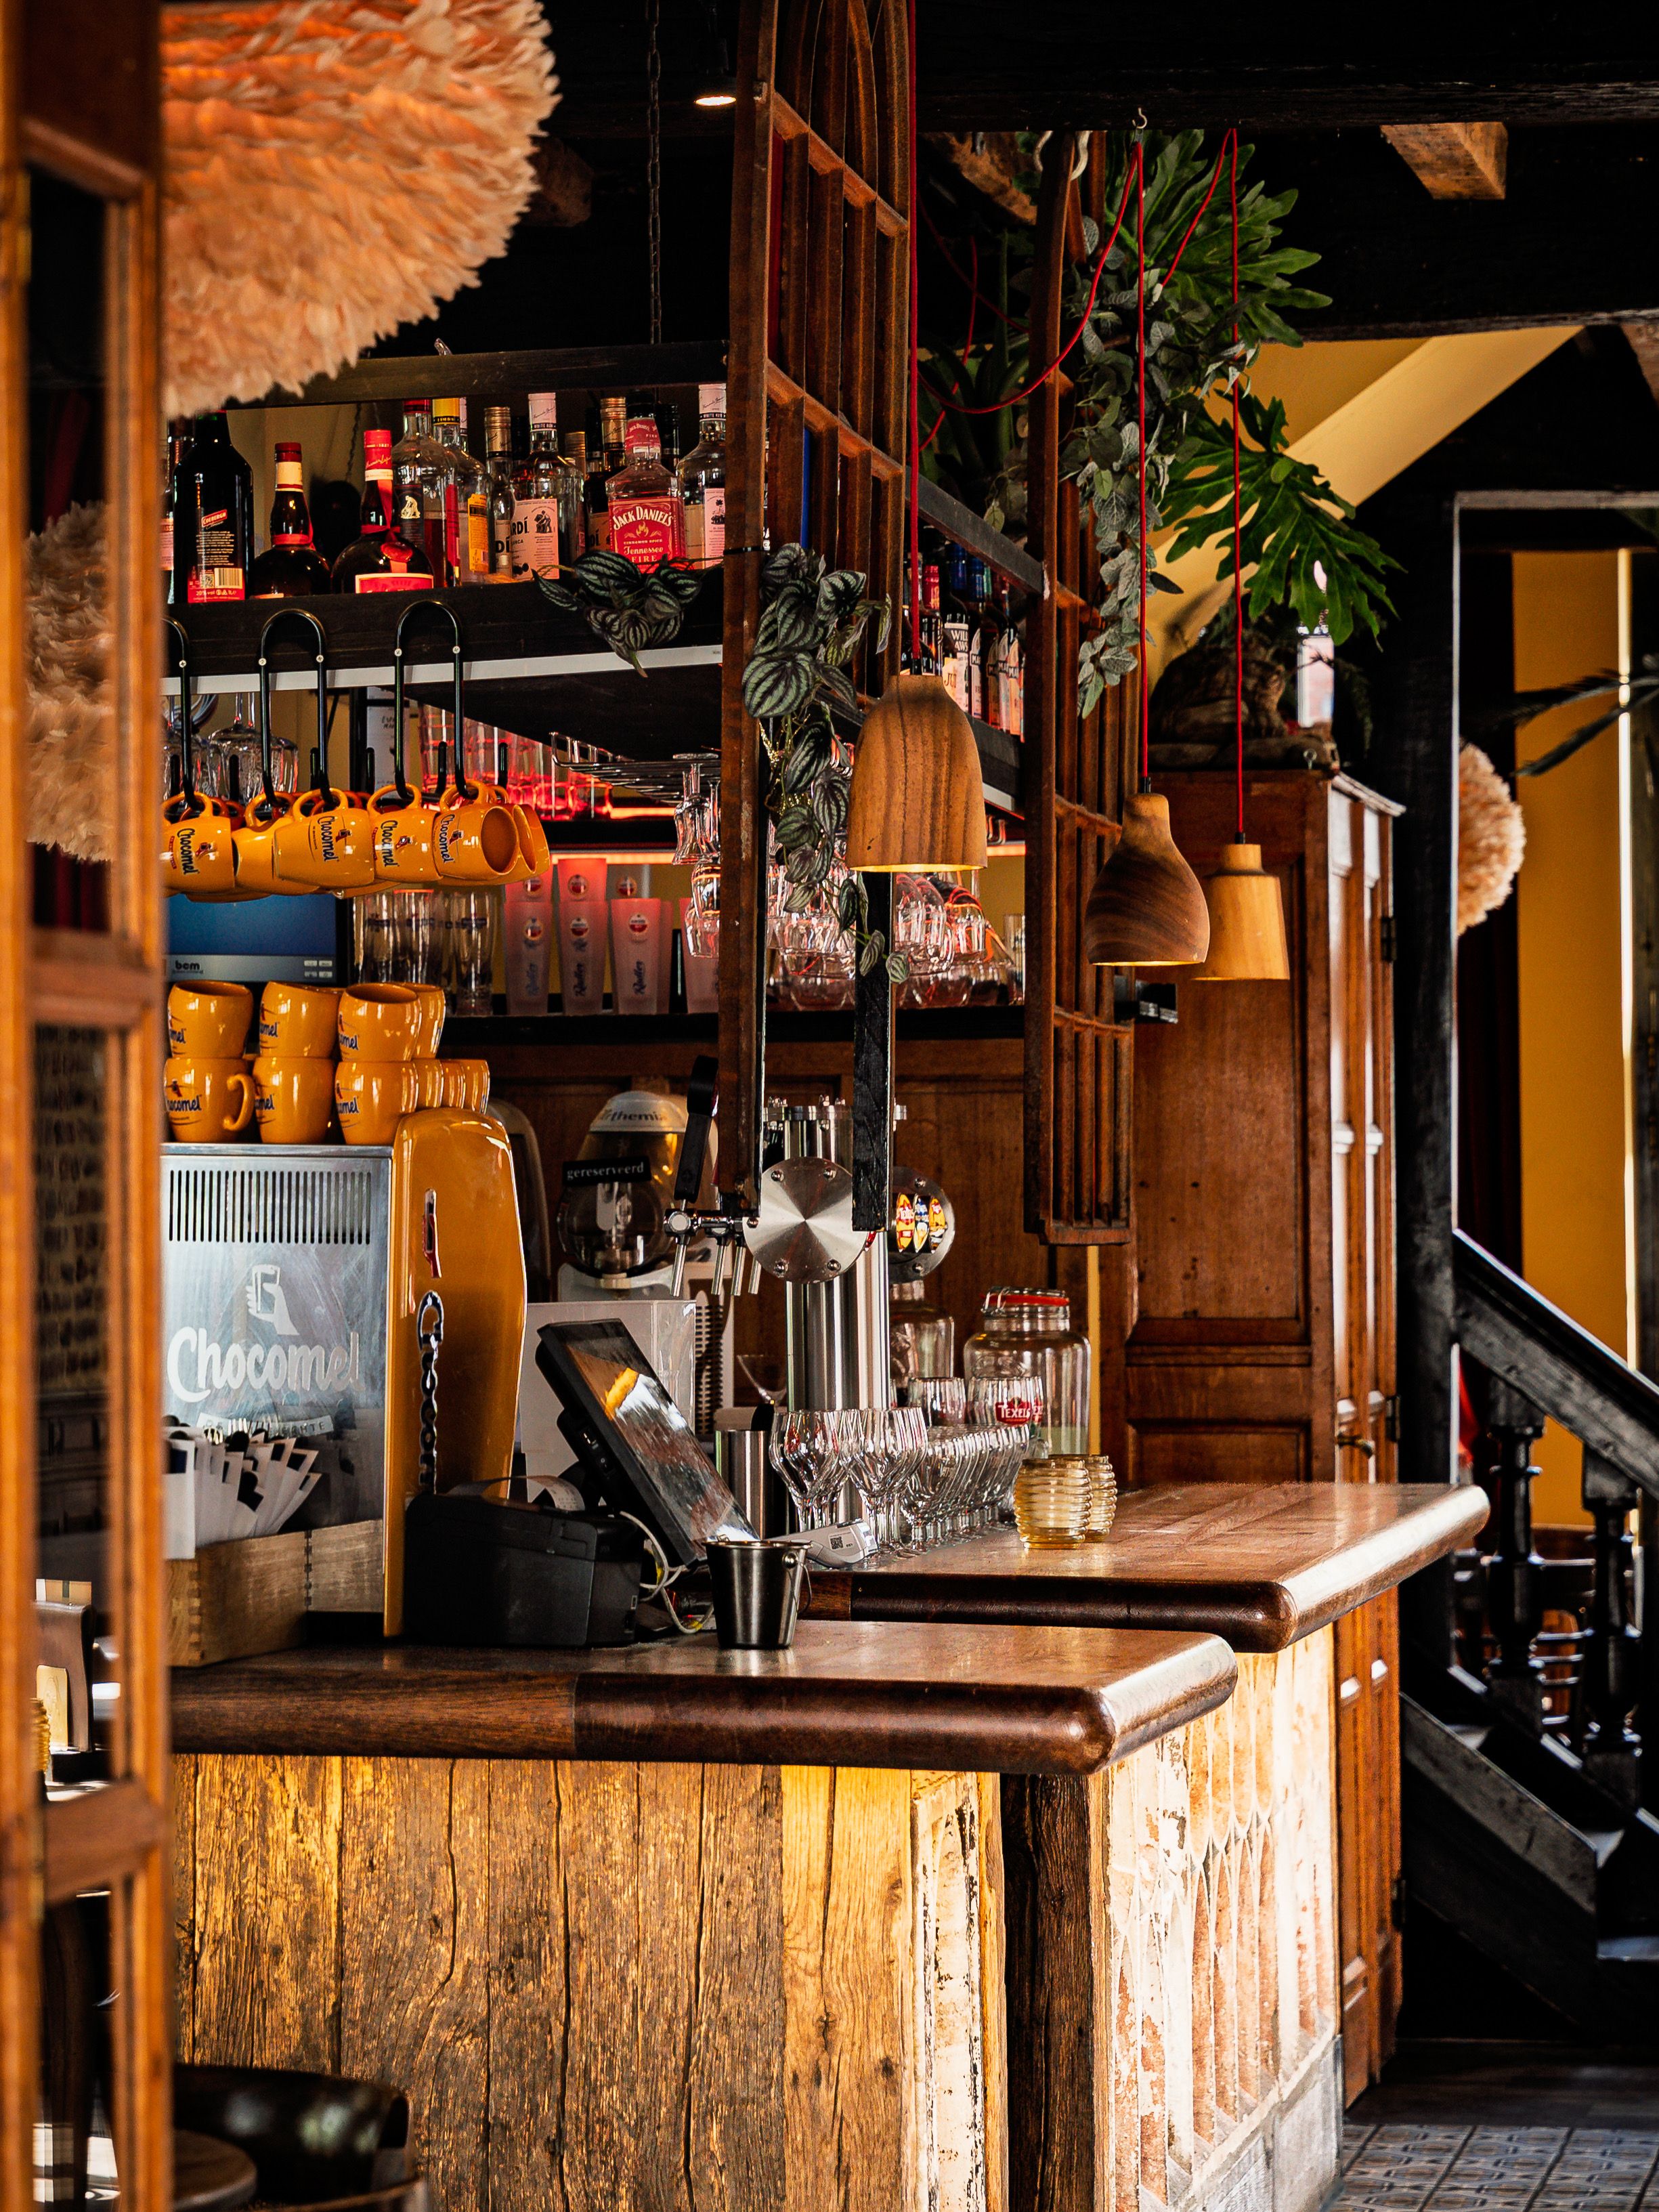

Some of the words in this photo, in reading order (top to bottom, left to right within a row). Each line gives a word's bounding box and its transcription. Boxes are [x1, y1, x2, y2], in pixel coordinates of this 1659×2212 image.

[202, 512, 226, 525] COEBERGH
[613, 510, 636, 530] JACK
[636, 506, 674, 527] DANIEL'S
[623, 546, 664, 555] Tennessee
[318, 815, 338, 862] Chocomel
[439, 814, 456, 864] Chocomel
[177, 828, 199, 875] Chocomel
[175, 960, 200, 970] bcm
[567, 1162, 644, 1181] gereserveerd
[167, 1326, 366, 1403] Chocomel
[997, 1404, 1031, 1418] TEXELS
